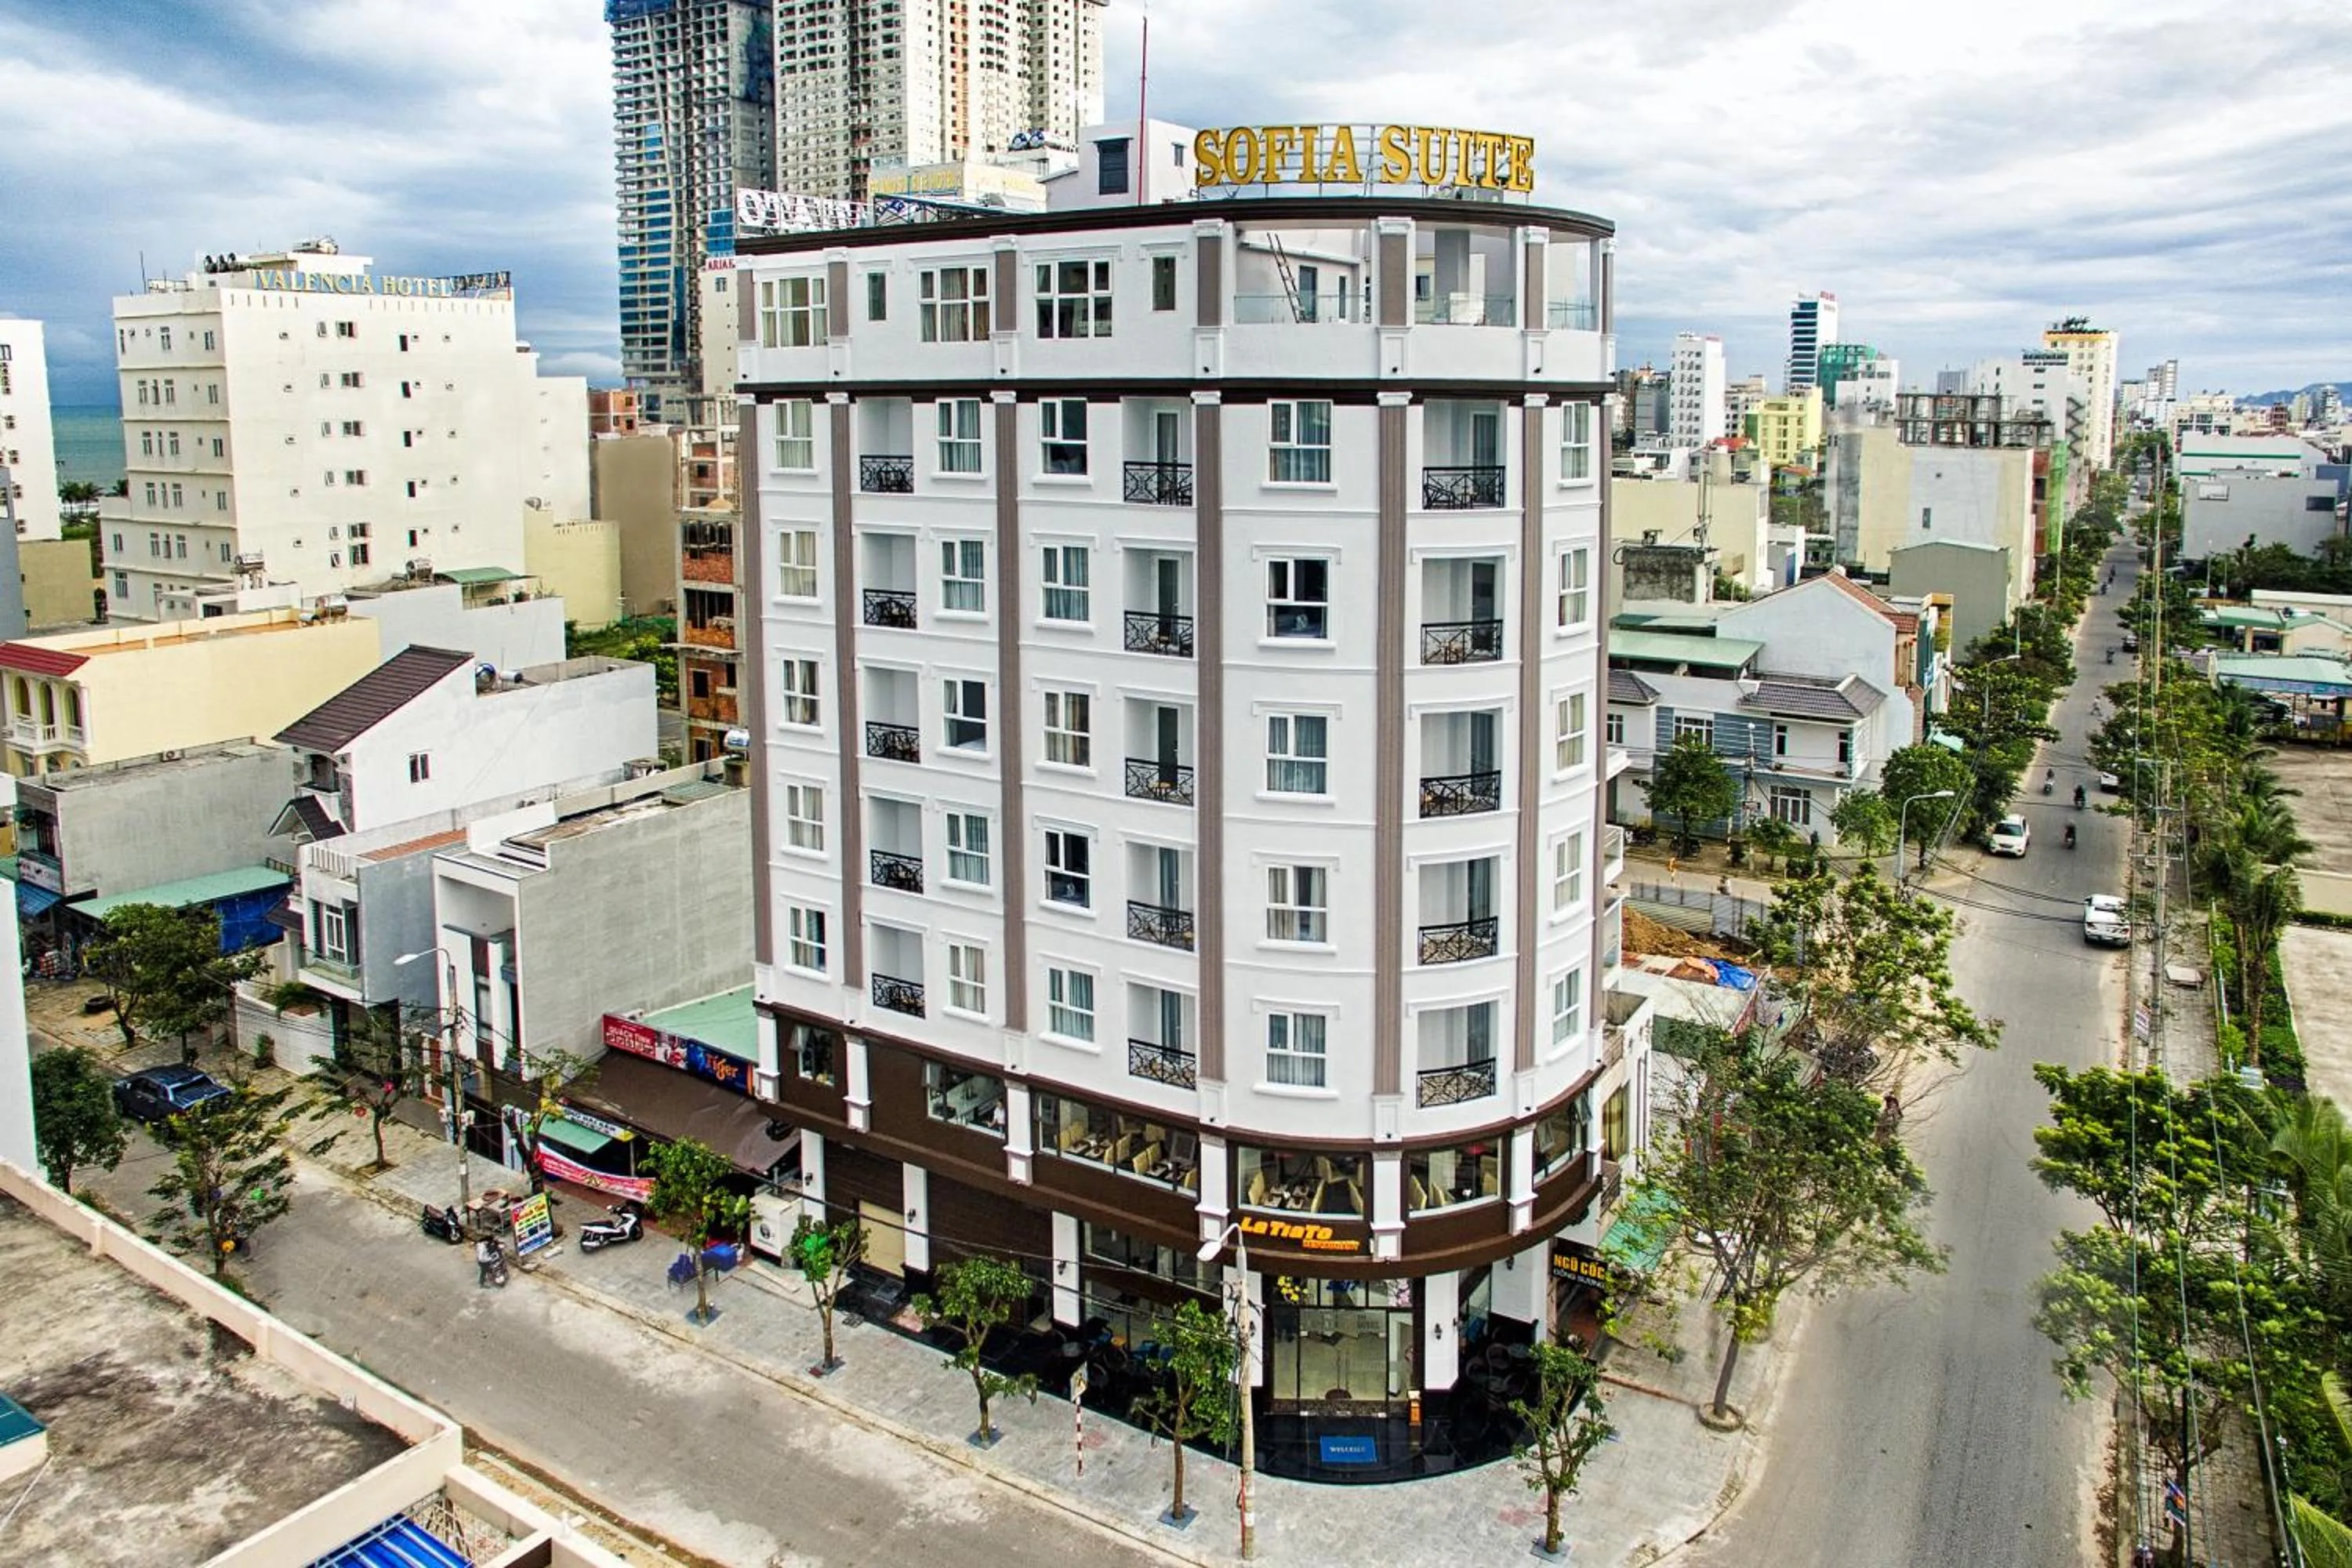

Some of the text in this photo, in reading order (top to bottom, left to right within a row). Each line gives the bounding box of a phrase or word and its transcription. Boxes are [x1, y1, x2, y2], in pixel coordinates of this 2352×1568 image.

[1194, 125, 1534, 193] SOFIA SUITE
[259, 270, 375, 295] VALENCIA
[381, 275, 453, 298] HOTEL
[706, 1053, 739, 1080] Tiger
[1581, 1261, 1605, 1280] CỐC
